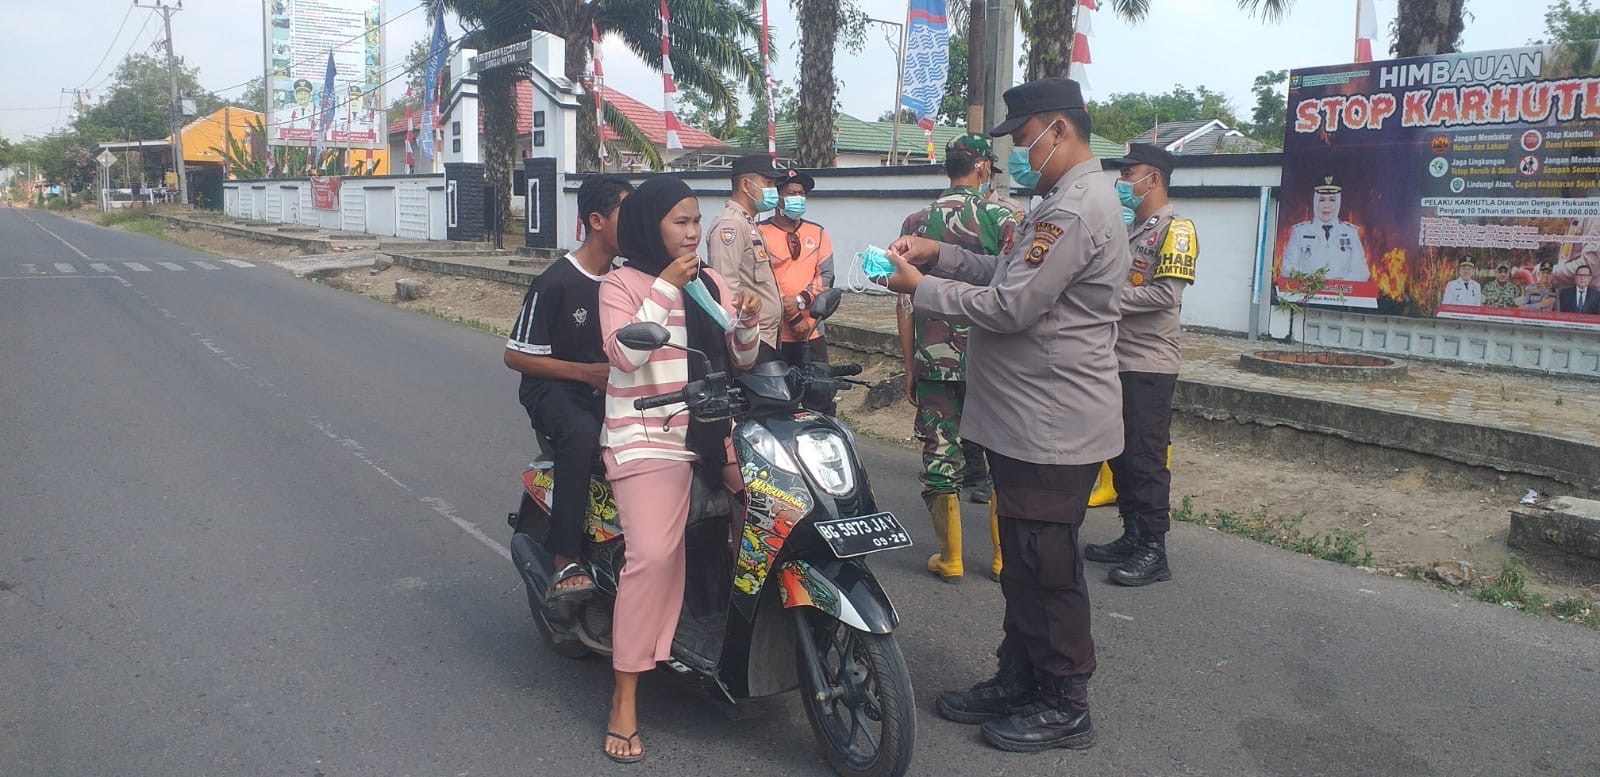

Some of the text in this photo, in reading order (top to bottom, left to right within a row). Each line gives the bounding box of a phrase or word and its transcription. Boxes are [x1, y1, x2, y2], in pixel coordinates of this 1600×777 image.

[1379, 52, 1541, 89] HIMBAUAN
[1295, 93, 1397, 133] STOP
[1454, 133, 1512, 143] Jangan Membakar
[1546, 131, 1561, 140] Stop
[1451, 159, 1467, 167] Jaga
[1467, 181, 1493, 189] Lindungi
[1531, 200, 1560, 208] Dengan
[1439, 207, 1465, 216] Penjara
[818, 514, 897, 540] BG 5973 JAY
